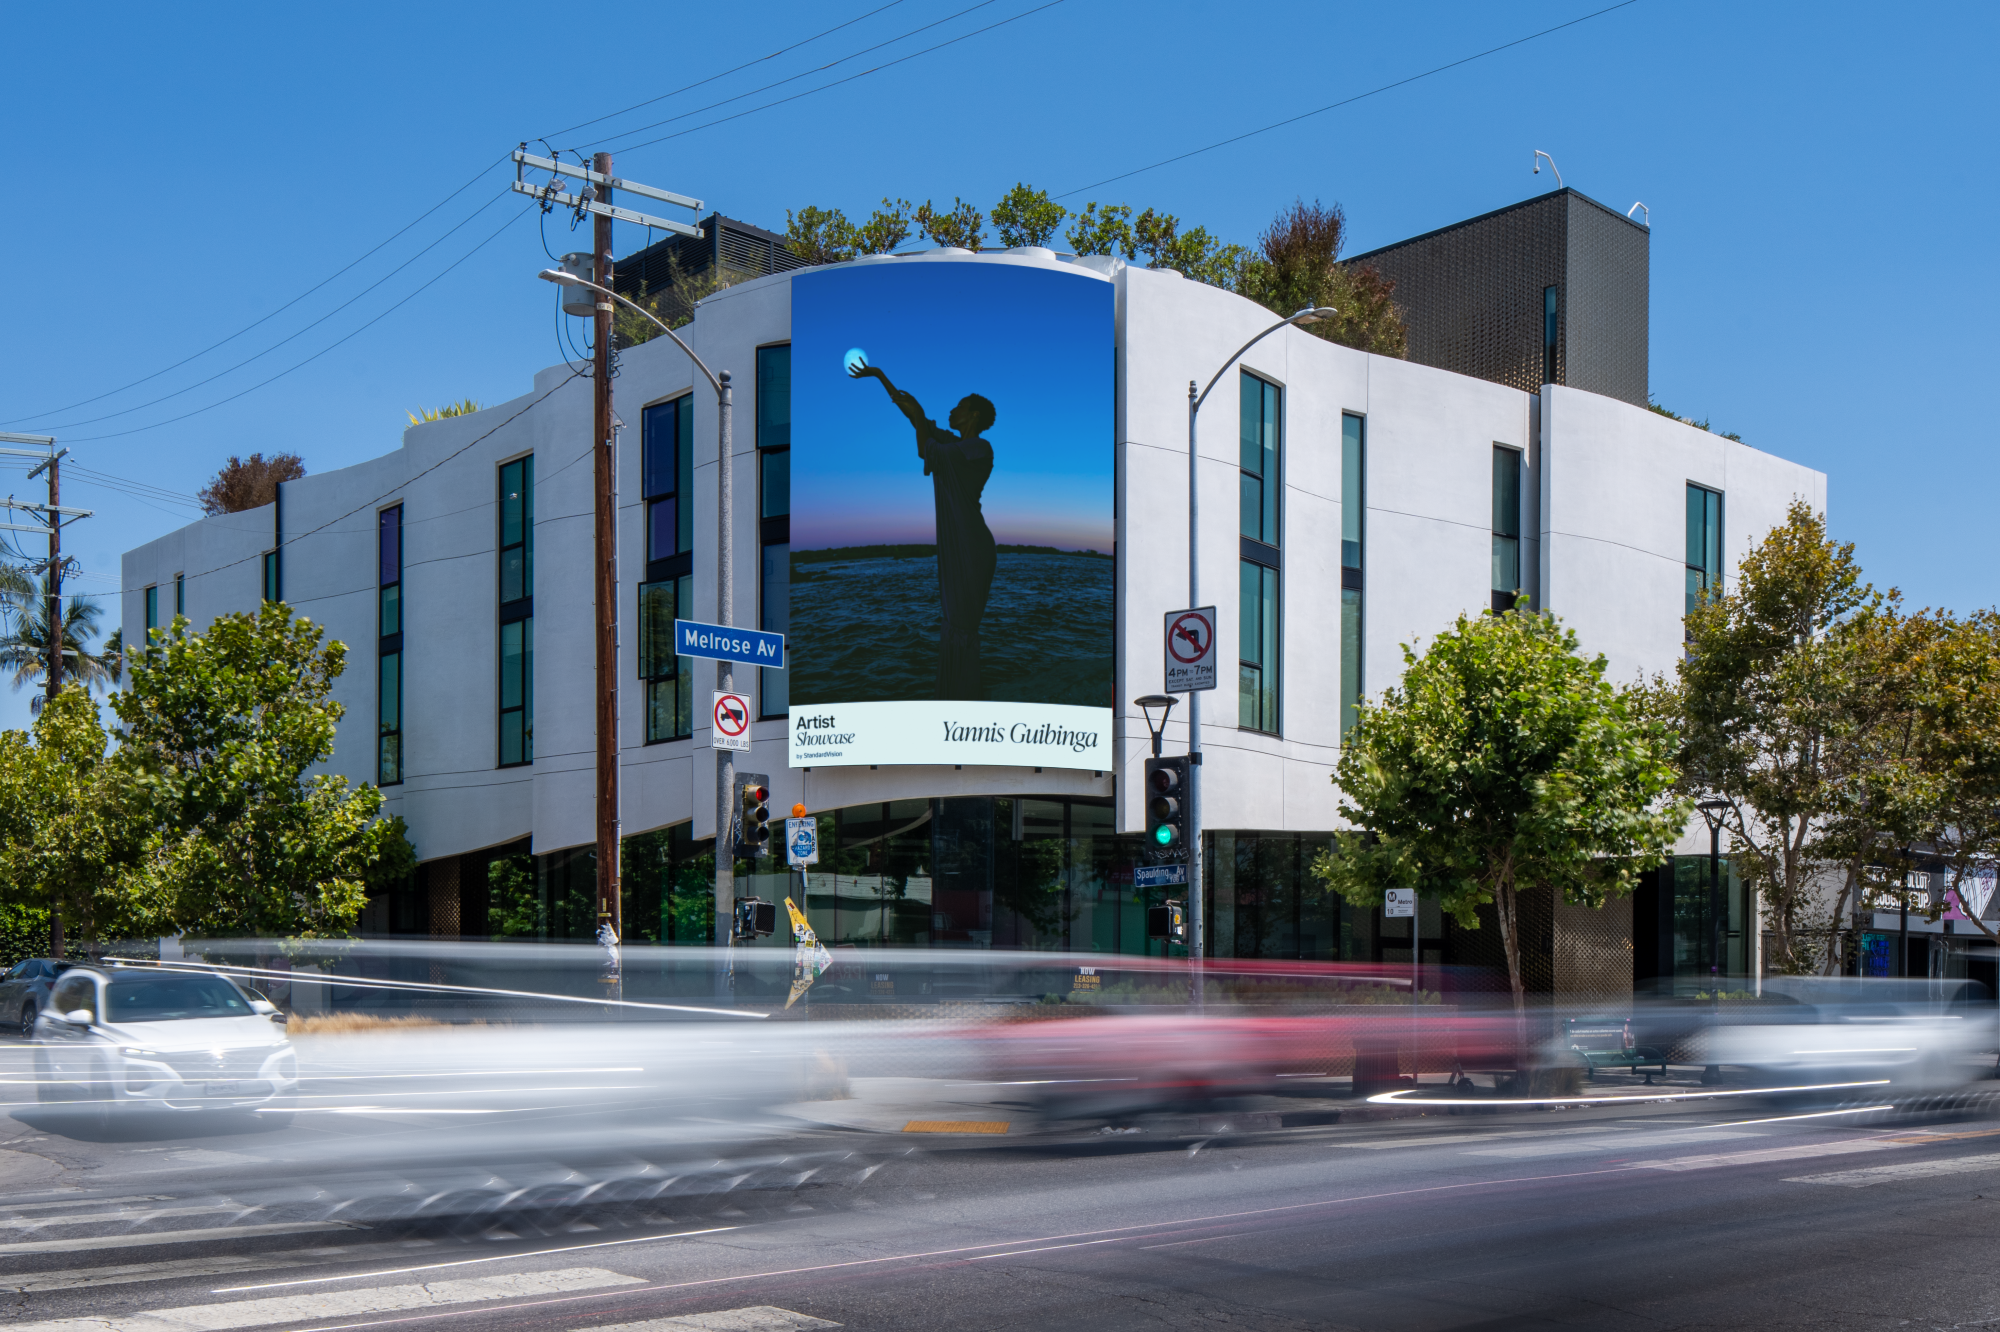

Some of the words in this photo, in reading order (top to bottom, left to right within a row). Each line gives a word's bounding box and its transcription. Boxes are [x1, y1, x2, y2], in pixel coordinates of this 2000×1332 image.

[685, 628, 751, 655] Melrose
[756, 639, 776, 657] Av
[796, 714, 836, 730] Artist
[795, 731, 856, 746] Showcase
[943, 721, 1006, 743] Yannis
[1010, 722, 1098, 752] Guibinga
[713, 737, 725, 745] OVER
[788, 820, 814, 828] ENTERING
[1136, 867, 1170, 881] Spaulding
[1176, 865, 1185, 875] Av
[1080, 967, 1095, 975] NOW
[875, 973, 889, 981] NOW
[1074, 975, 1100, 983] LEASING
[871, 981, 894, 989] LEASING
